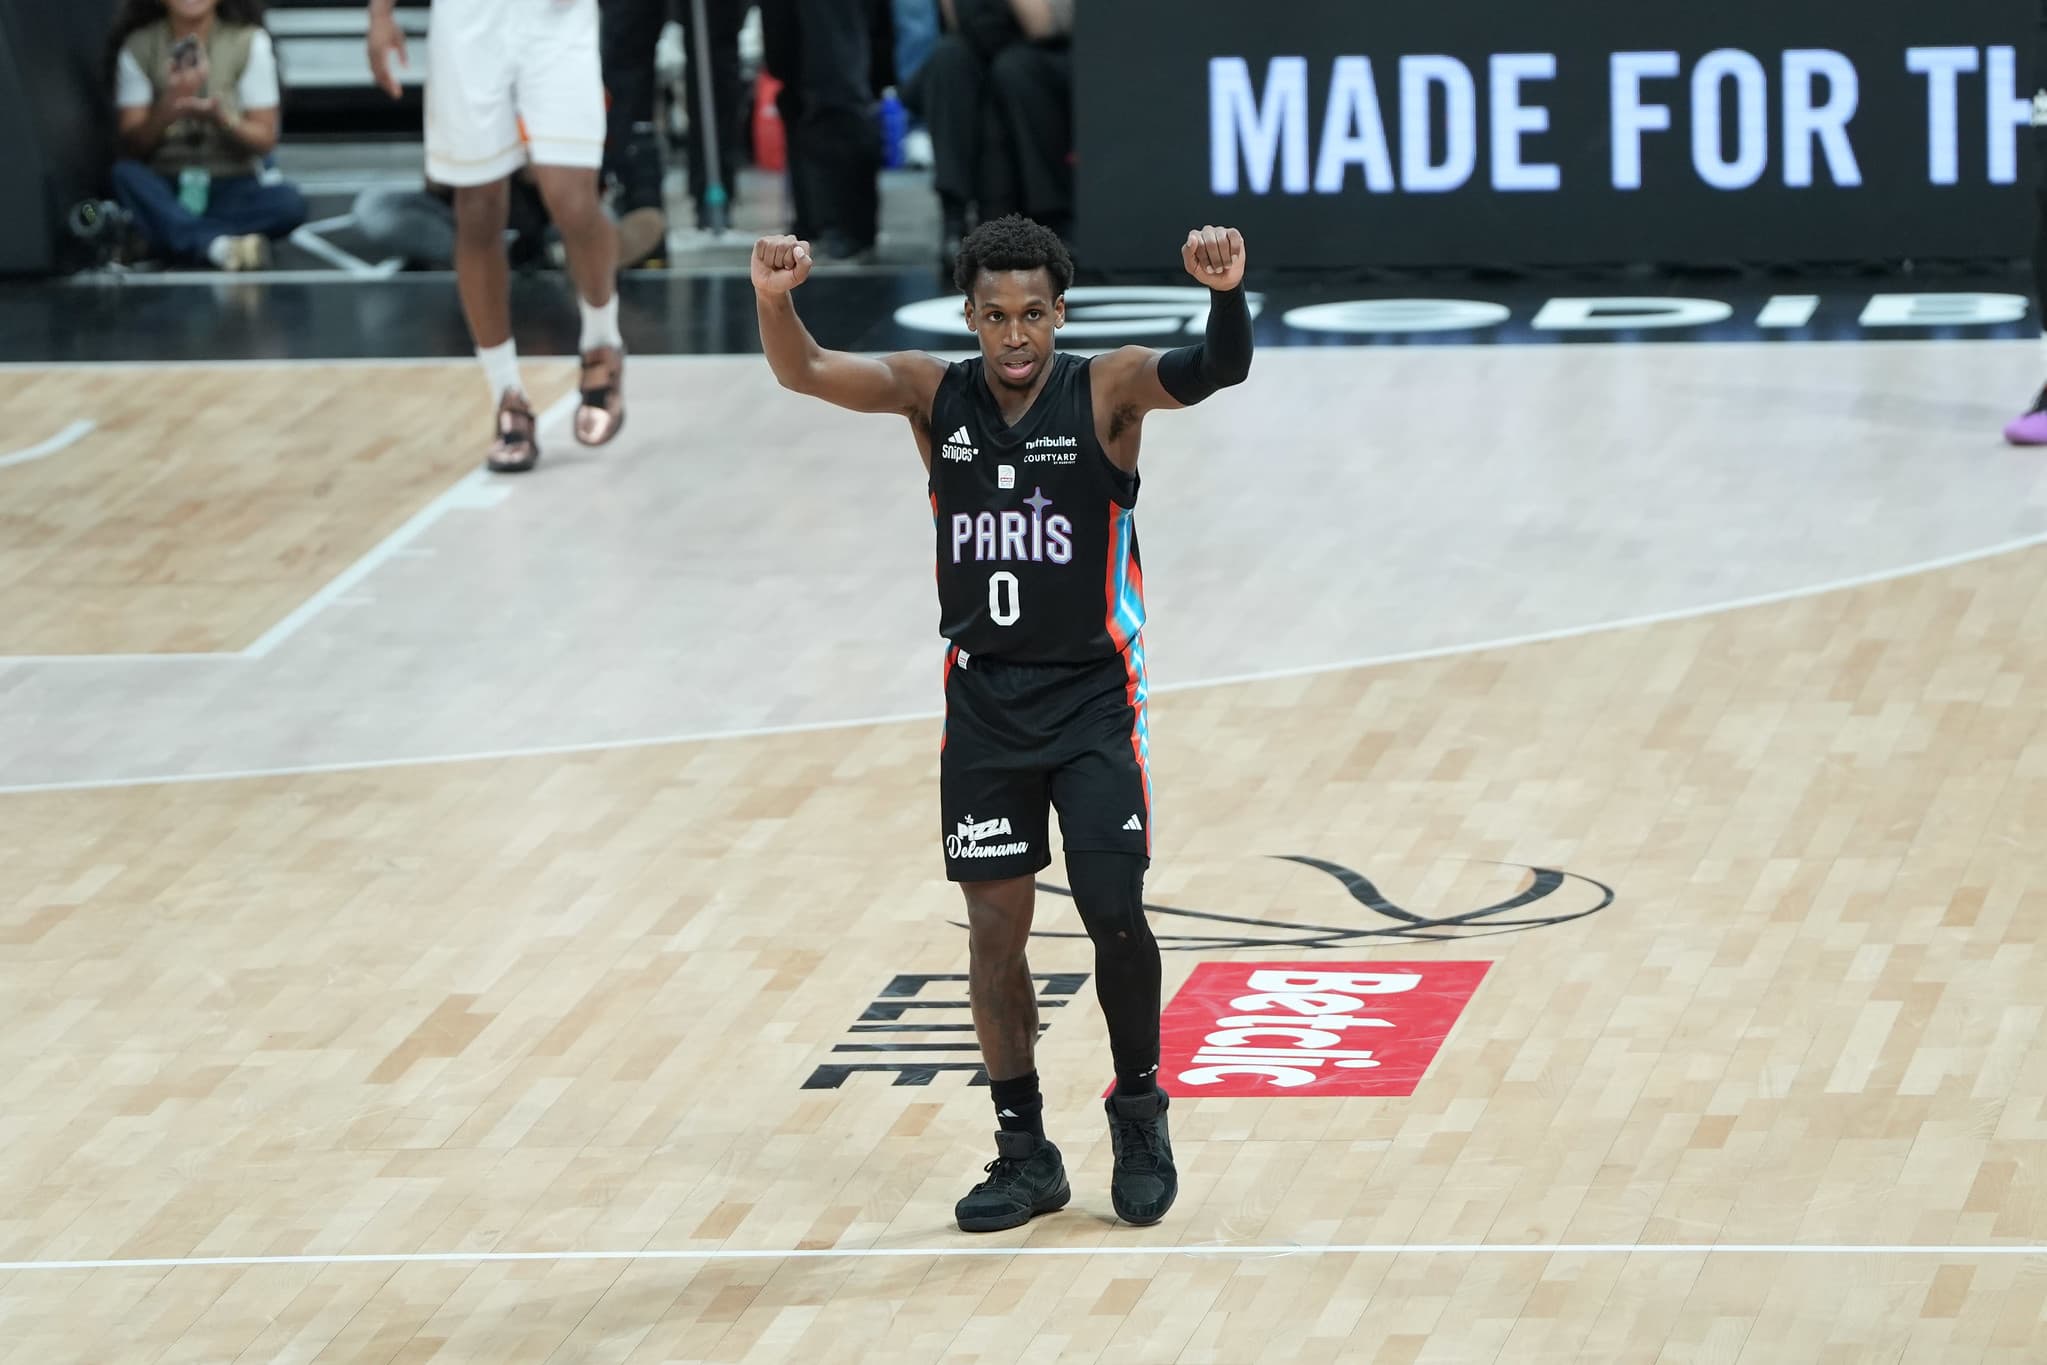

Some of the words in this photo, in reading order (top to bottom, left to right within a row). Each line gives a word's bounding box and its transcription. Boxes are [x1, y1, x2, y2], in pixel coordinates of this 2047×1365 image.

[1209, 53, 1561, 194] MADE
[1610, 48, 1862, 190] FOR
[1023, 453, 1077, 463] COURTYARD
[951, 510, 1073, 565] PARIS
[988, 571, 1021, 627] 0
[946, 834, 1029, 859] Delamama
[1177, 970, 1423, 1088] Betclic
